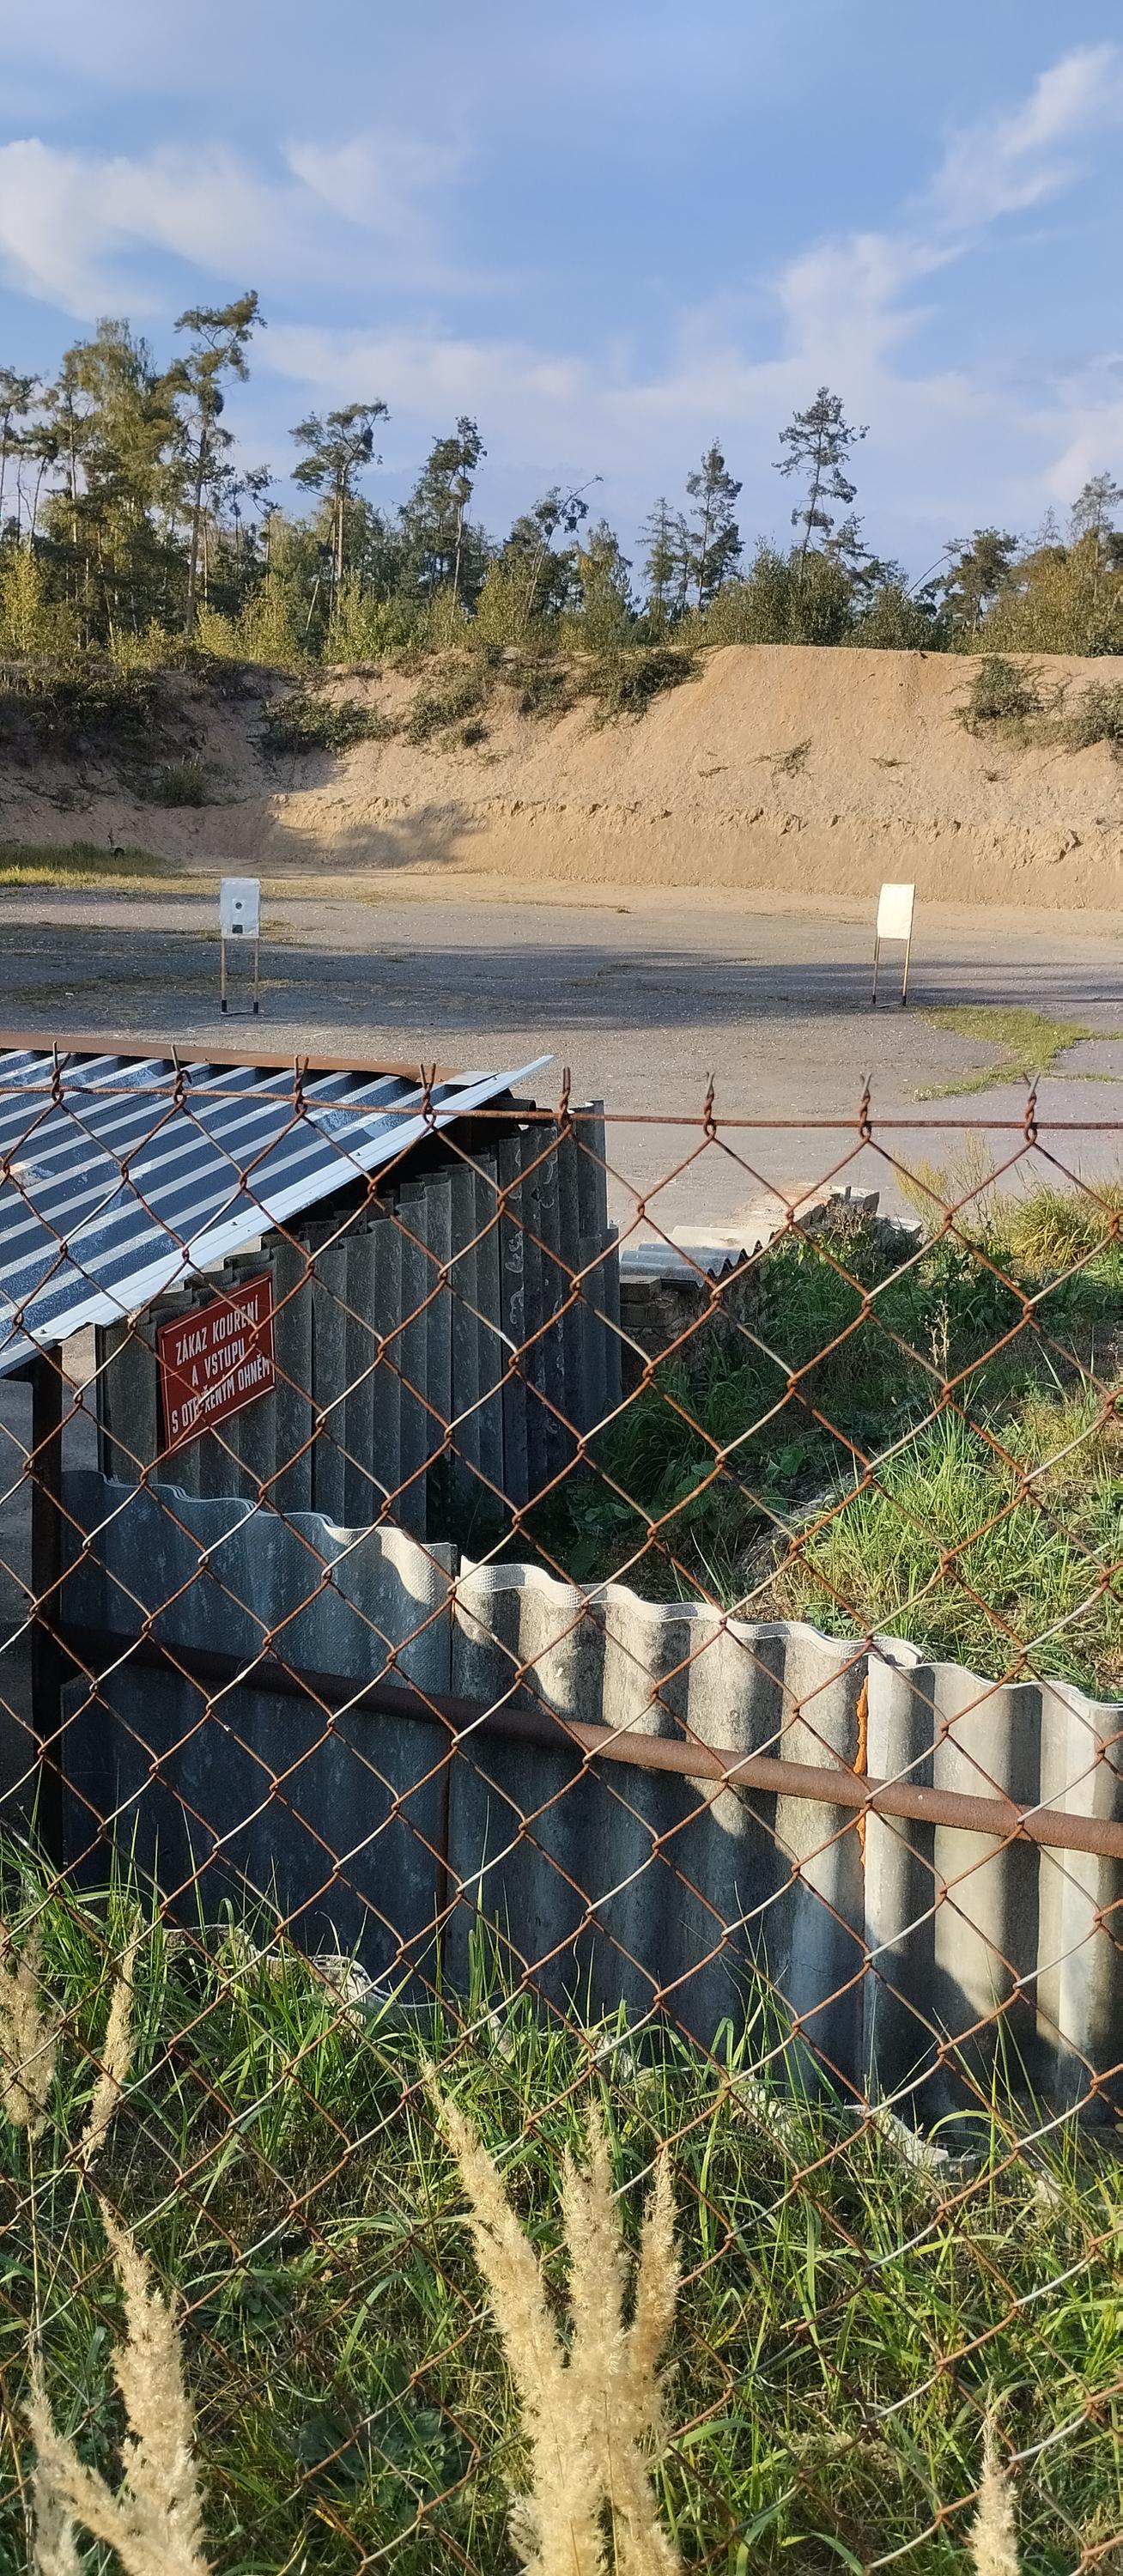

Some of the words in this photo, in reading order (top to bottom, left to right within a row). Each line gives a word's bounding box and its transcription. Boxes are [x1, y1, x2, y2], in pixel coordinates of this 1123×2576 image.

[175, 1327, 207, 1366] ZÁKAZ
[191, 1365, 199, 1387] A
[204, 1338, 245, 1379] VSTUPU
[172, 1410, 179, 1434] S
[181, 1374, 235, 1427] OTEŘENÝM
[238, 1353, 270, 1391] OHNĚM
